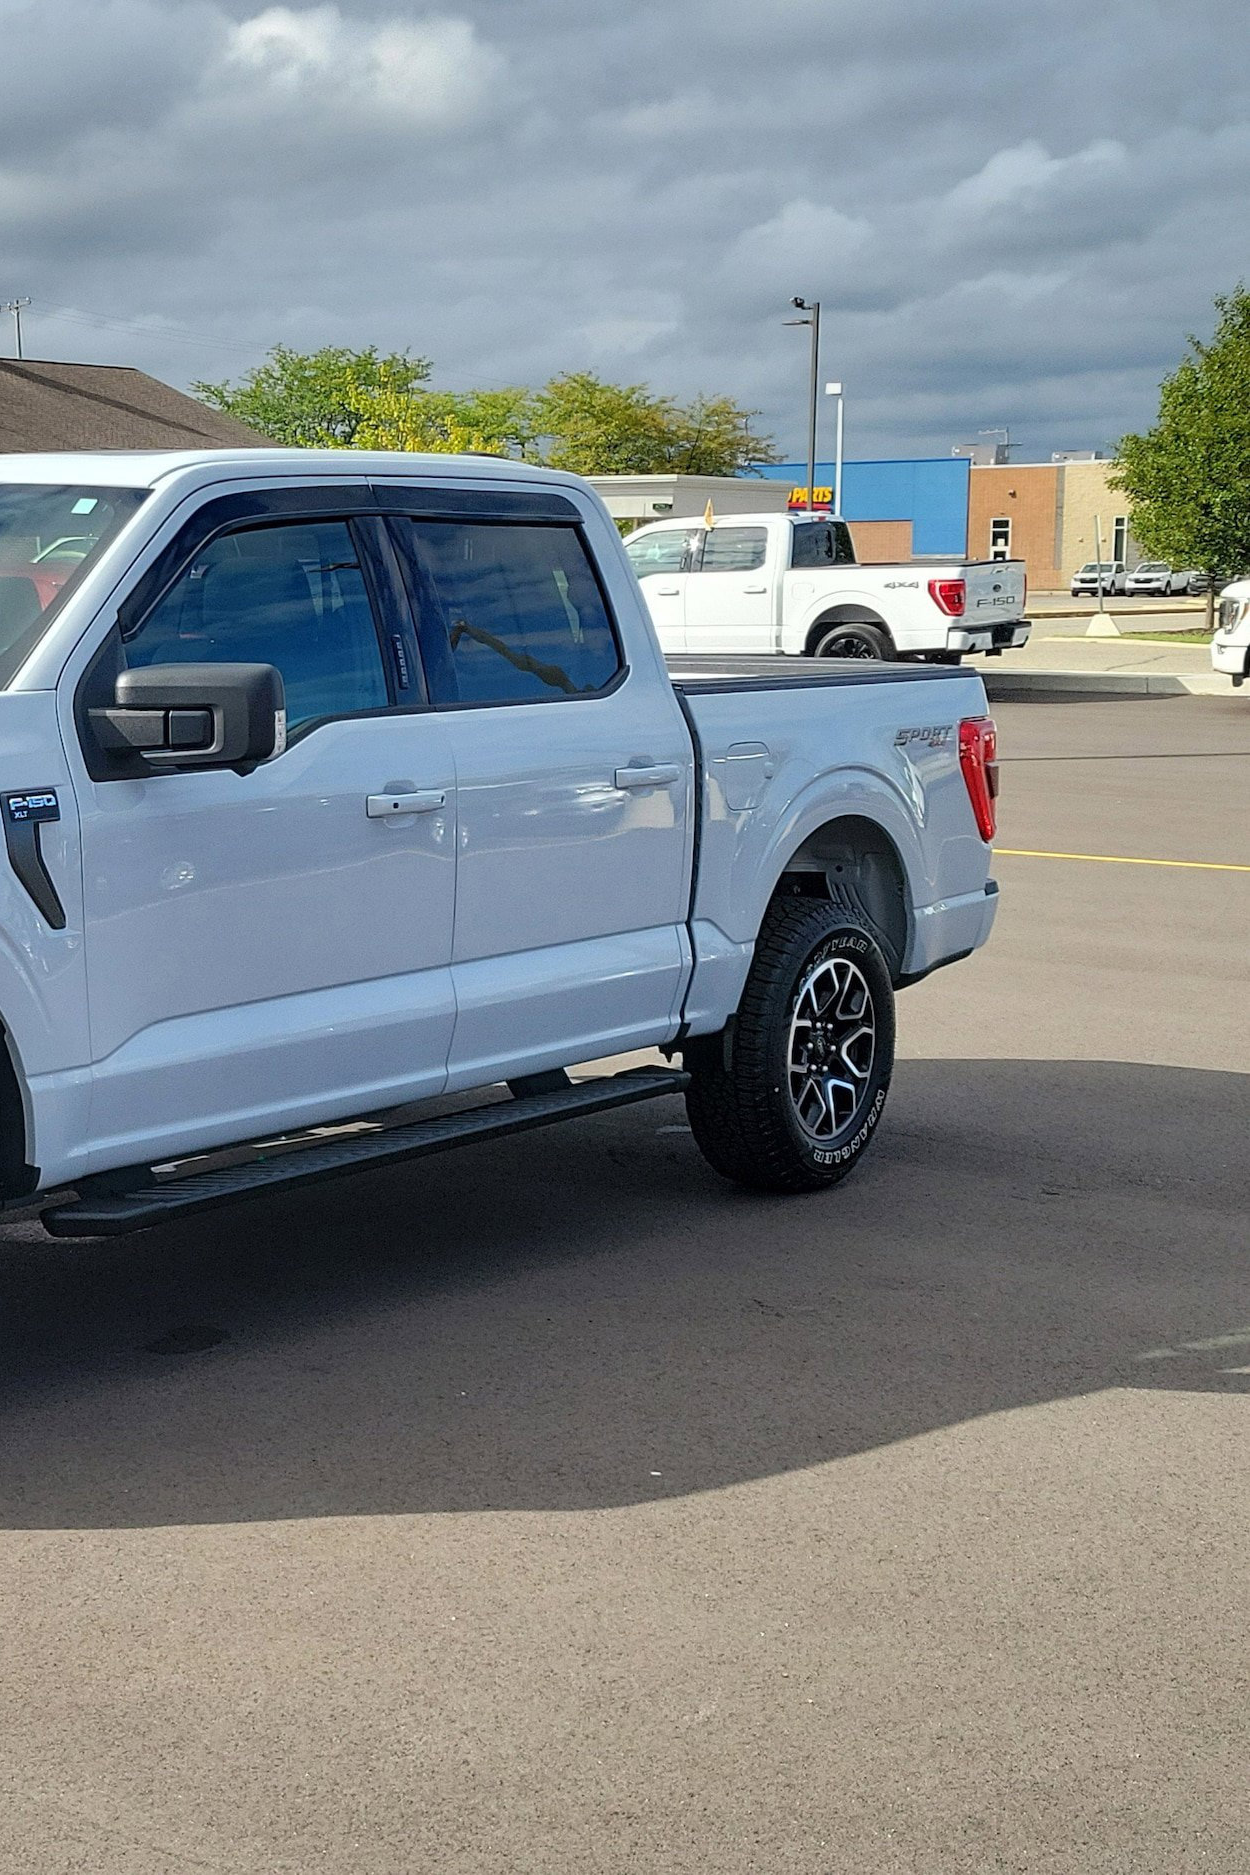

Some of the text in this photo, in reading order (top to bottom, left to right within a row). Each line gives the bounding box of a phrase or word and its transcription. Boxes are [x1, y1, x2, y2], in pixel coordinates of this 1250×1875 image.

[791, 487, 832, 503] PARTS
[976, 596, 1015, 608] F-150
[893, 725, 953, 746] SPORT
[8, 793, 57, 811] F-150
[14, 810, 29, 819] XLT
[813, 1089, 886, 1164] WRANGLER
